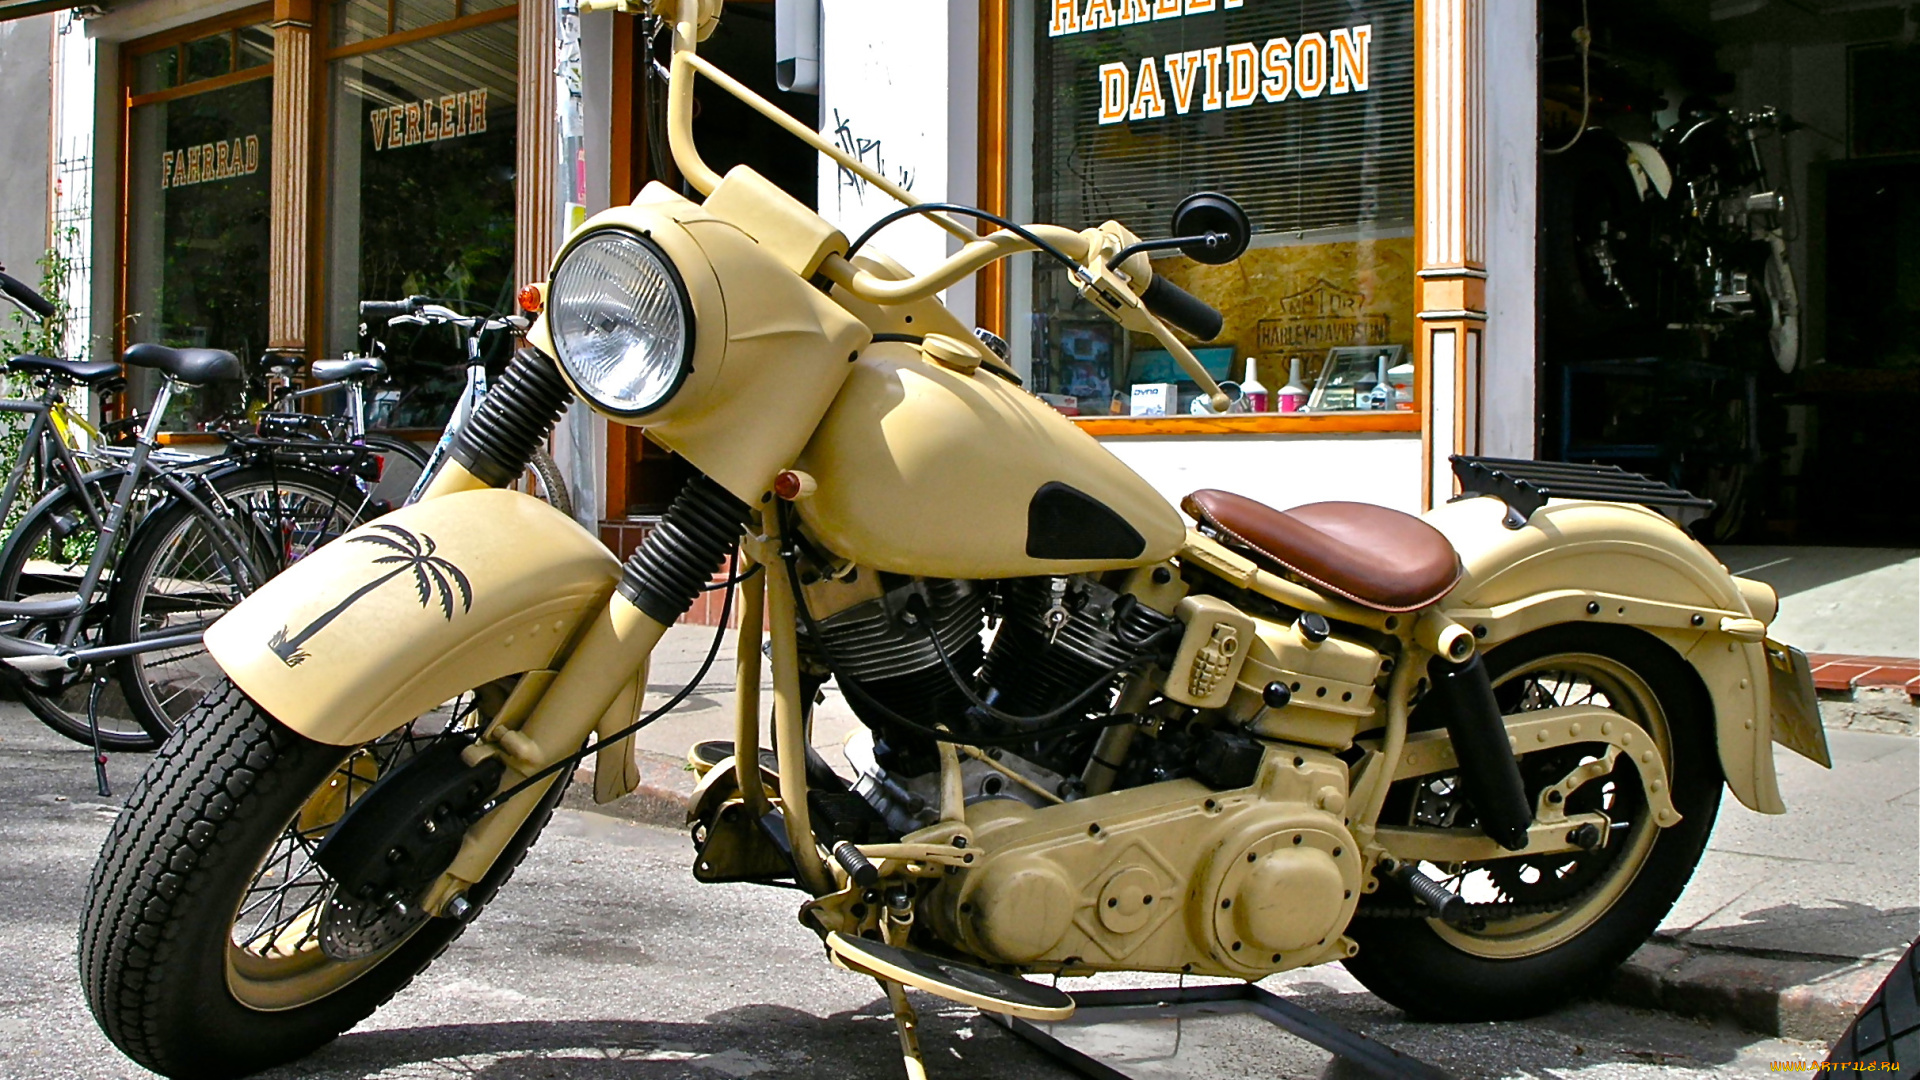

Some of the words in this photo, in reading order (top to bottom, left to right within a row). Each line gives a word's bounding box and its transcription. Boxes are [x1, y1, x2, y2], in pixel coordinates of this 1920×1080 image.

[1098, 24, 1371, 125] DAVIDSON
[370, 87, 488, 151] VERLEIH
[161, 134, 259, 190] FAHRRAD
